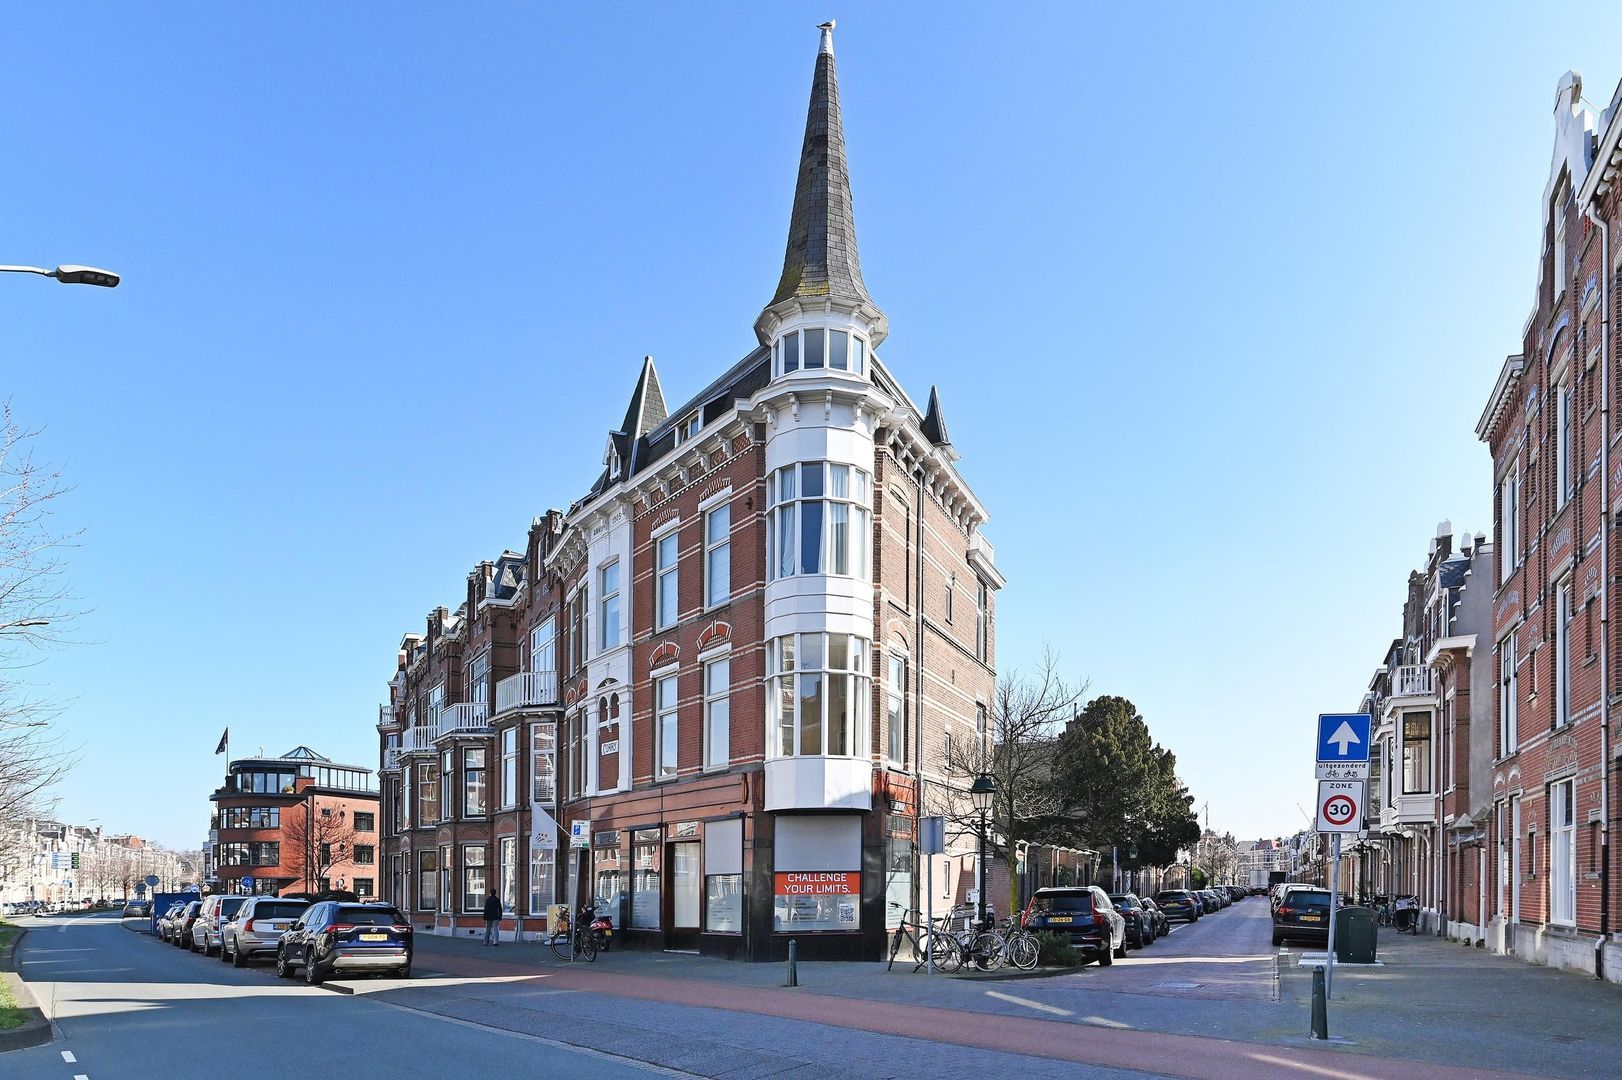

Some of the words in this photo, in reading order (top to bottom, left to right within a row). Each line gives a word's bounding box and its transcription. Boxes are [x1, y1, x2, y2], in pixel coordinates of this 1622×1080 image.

[1329, 804, 1351, 816] 30
[787, 873, 848, 882] CHALLENGE
[784, 884, 814, 893] YOUR
[816, 884, 851, 893] LIMITS.
